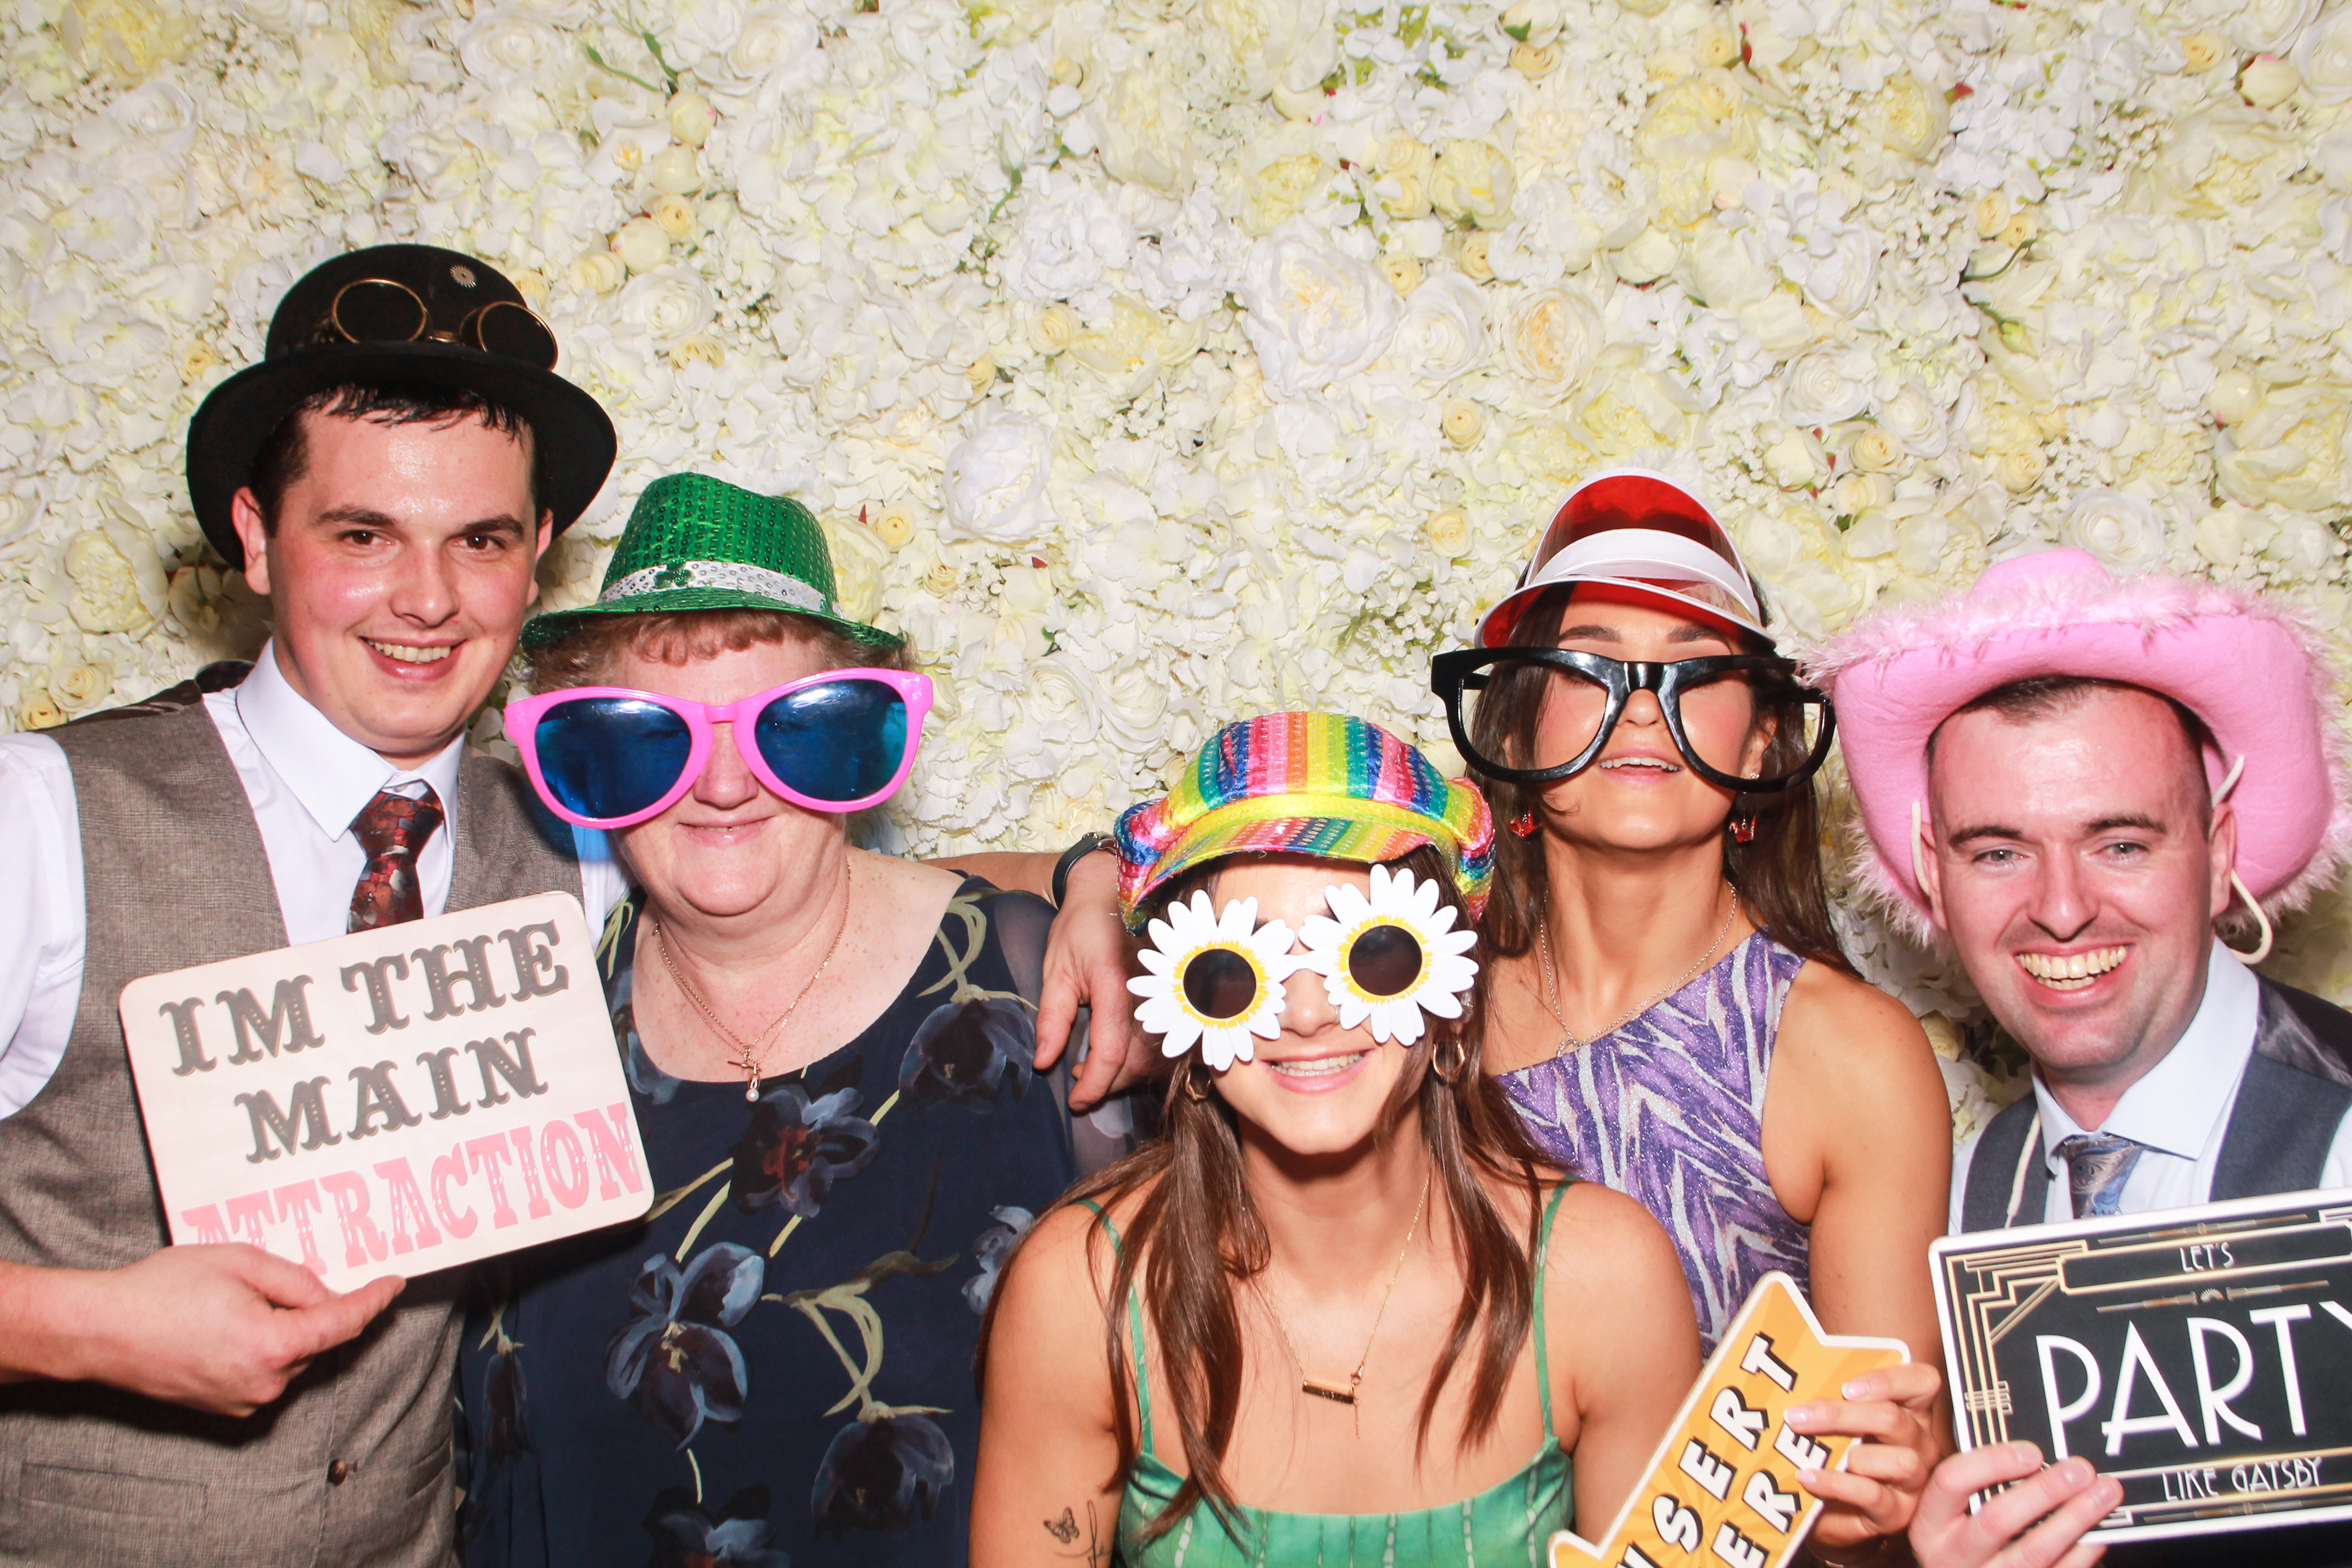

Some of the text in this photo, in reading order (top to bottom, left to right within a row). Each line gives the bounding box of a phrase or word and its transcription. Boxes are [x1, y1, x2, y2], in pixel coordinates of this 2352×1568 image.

[159, 919, 570, 1076] IM THE
[233, 1027, 549, 1164] MAIN
[2179, 1242, 2235, 1273] LET'S
[1615, 1331, 1798, 1568] SERT
[1711, 1422, 1832, 1568] ERE
[2162, 1456, 2323, 1502] LIKE GATSBY
